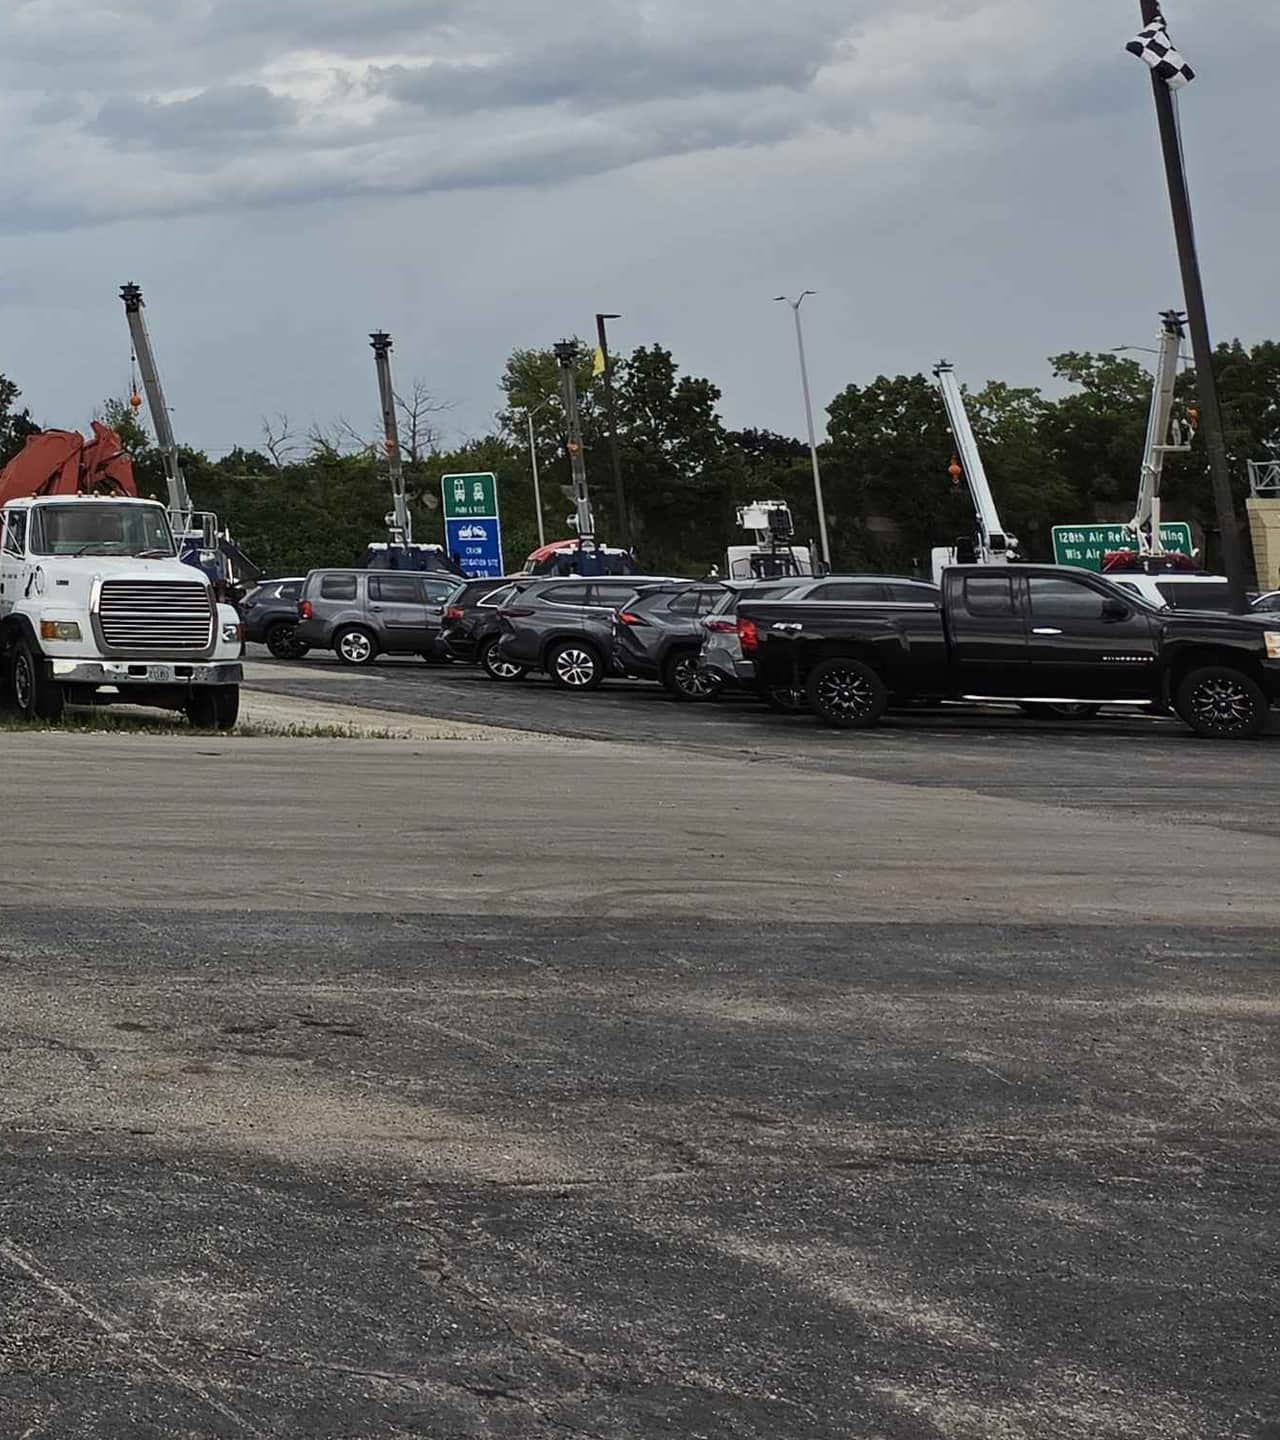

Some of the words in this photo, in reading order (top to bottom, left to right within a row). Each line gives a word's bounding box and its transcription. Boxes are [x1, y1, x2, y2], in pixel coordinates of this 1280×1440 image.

[1089, 531, 1104, 543] Air
[1160, 530, 1184, 544] Wing
[1085, 548, 1100, 559] Air
